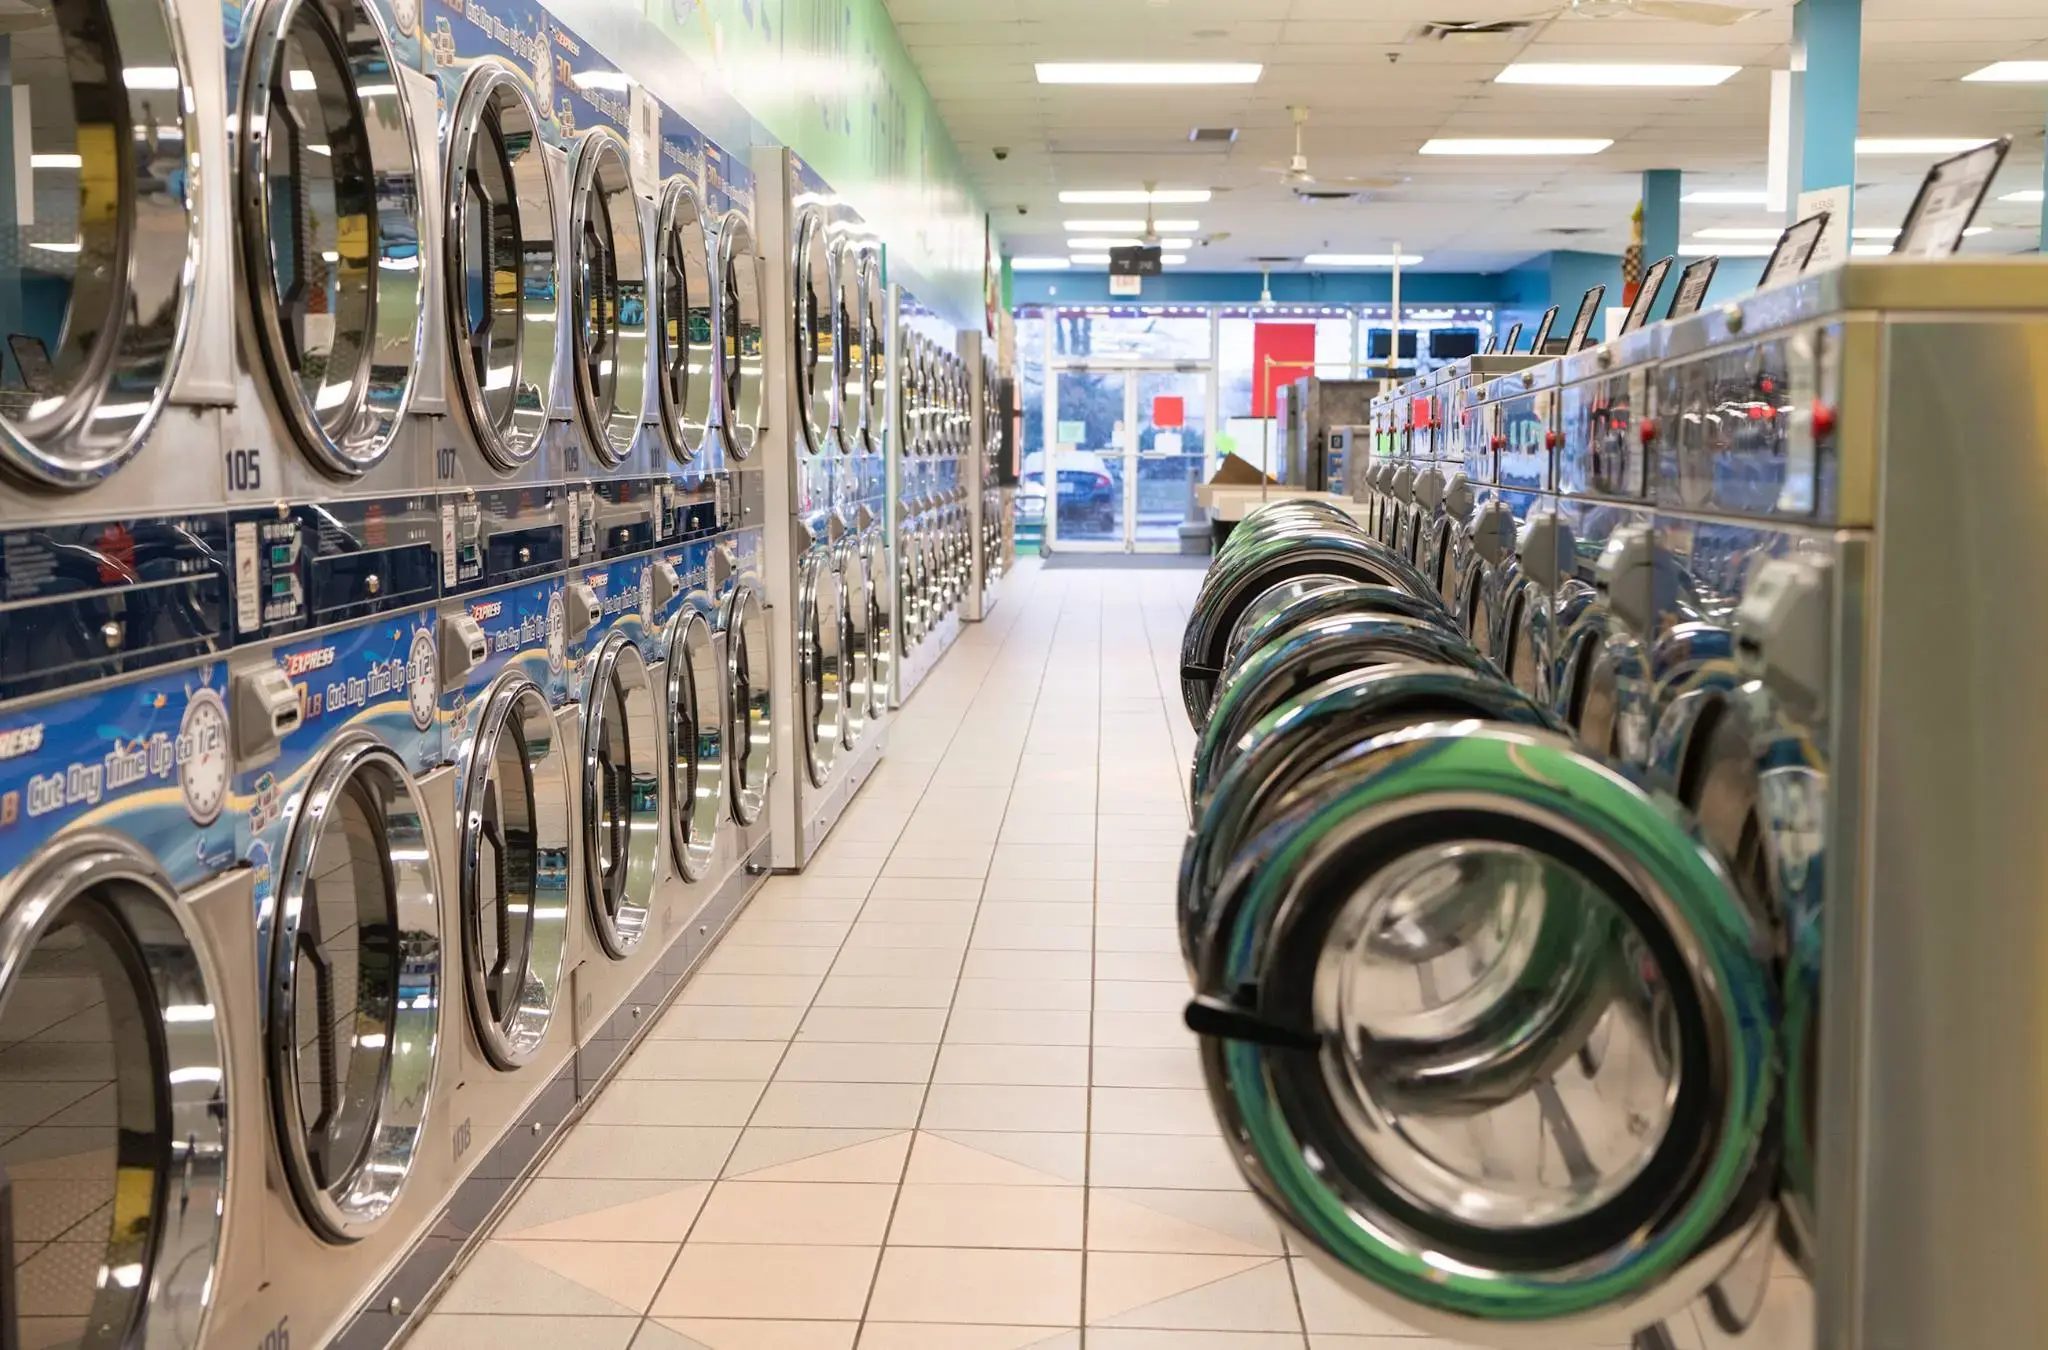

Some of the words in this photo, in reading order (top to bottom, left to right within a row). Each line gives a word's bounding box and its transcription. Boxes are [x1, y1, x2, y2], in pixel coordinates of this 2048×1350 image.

[226, 449, 261, 491] 105
[437, 448, 456, 479] 107
[564, 447, 578, 472] 109
[289, 647, 335, 677] EXPRESS
[326, 682, 347, 712] Cut
[347, 677, 366, 707] Dry
[367, 668, 391, 698] Time
[392, 658, 405, 693] Up
[406, 661, 417, 683] to
[27, 772, 66, 817] Cut
[66, 761, 103, 805] Dry
[105, 748, 149, 790] Time
[149, 732, 174, 778] Up
[175, 733, 194, 766] to
[452, 1116, 471, 1164] 108
